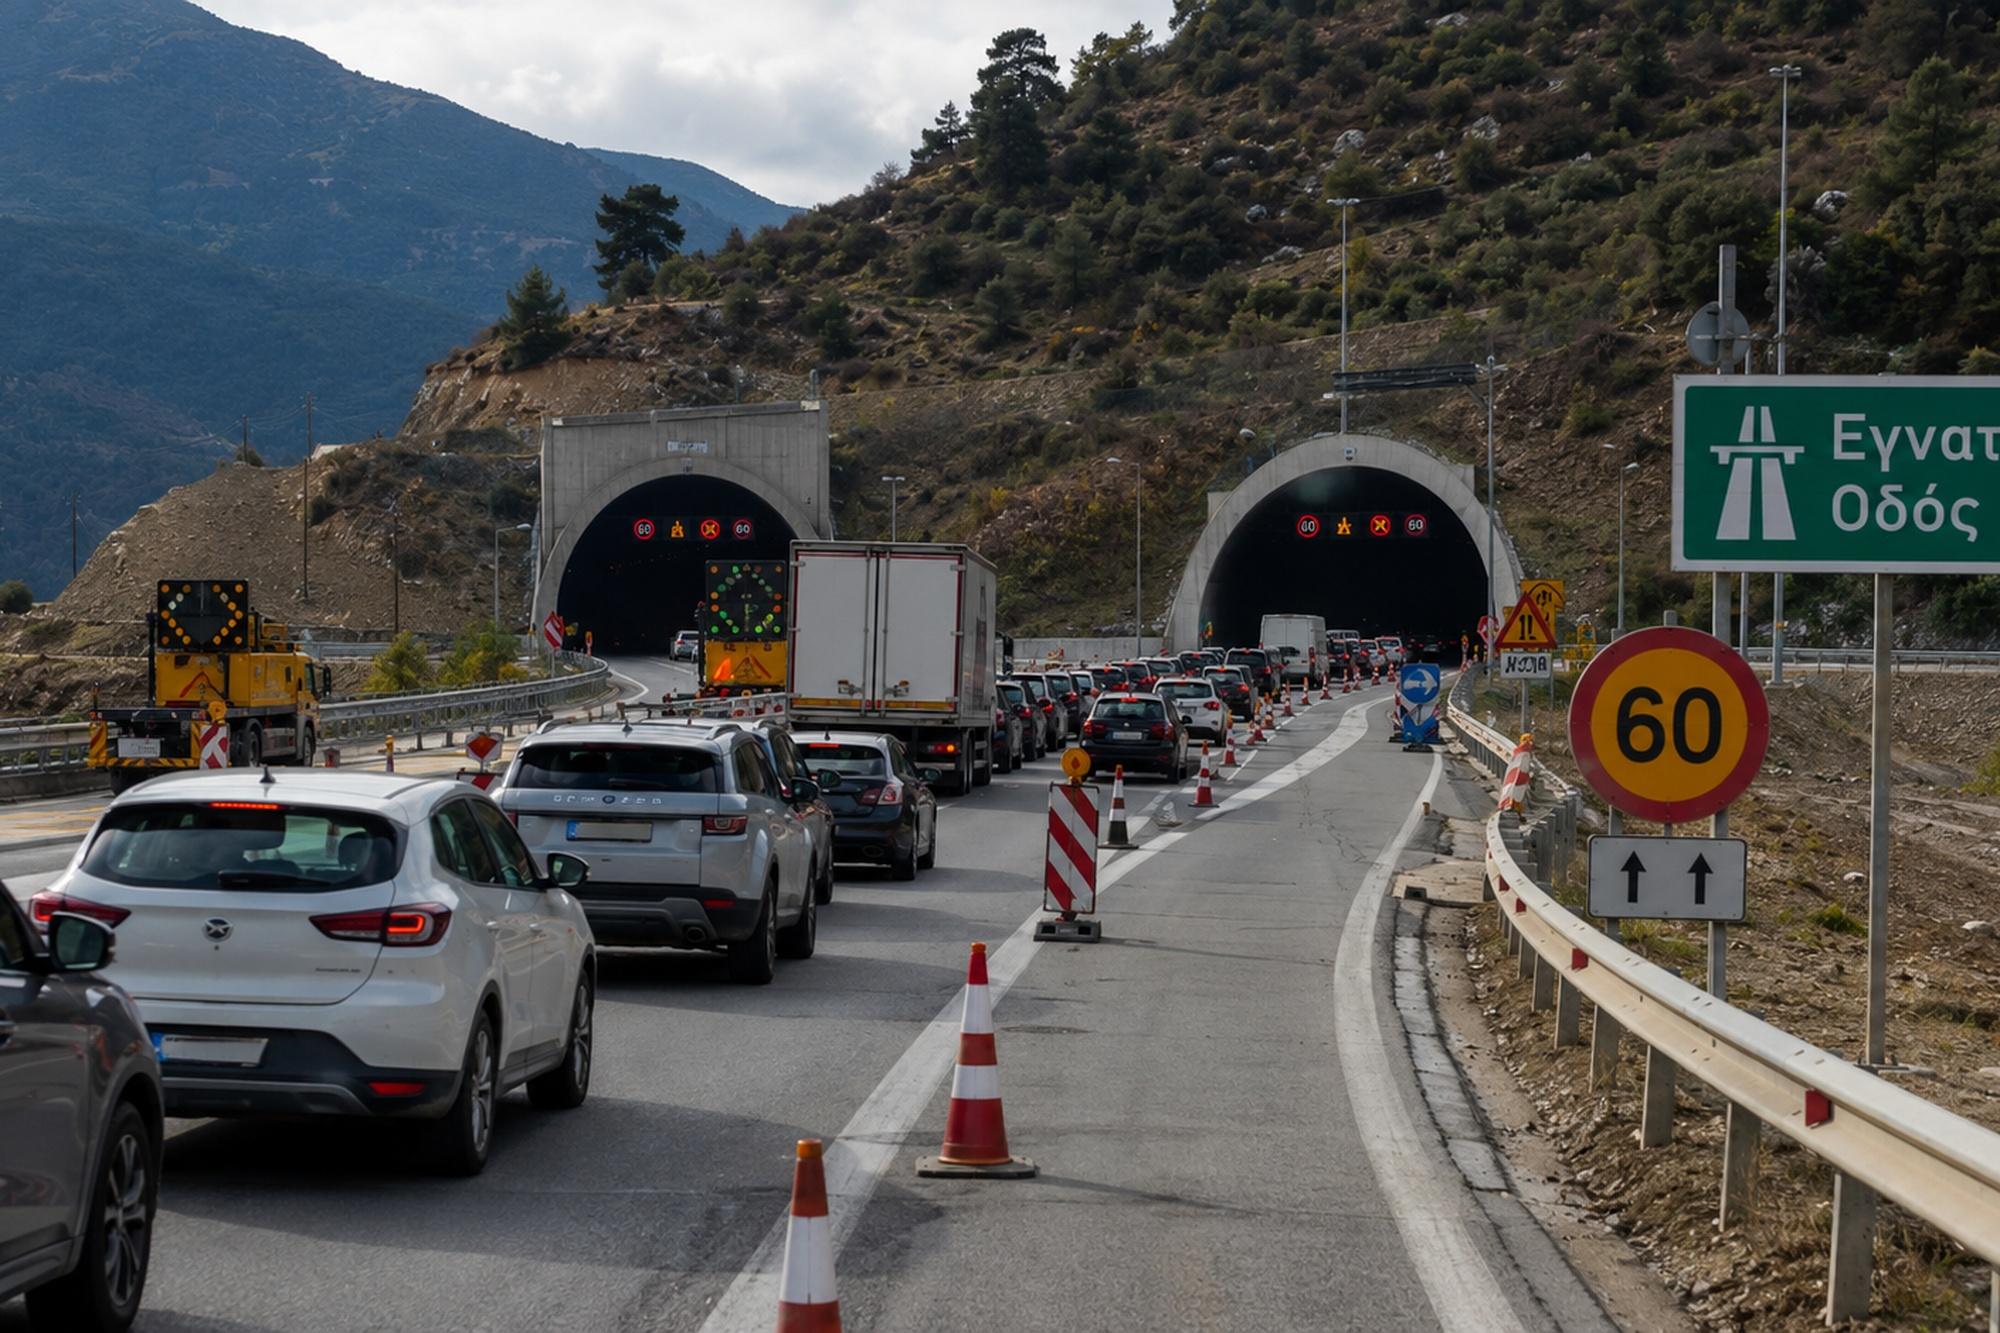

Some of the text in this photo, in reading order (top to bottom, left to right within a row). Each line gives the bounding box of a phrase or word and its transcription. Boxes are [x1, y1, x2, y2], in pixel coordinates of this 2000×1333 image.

[1833, 412, 2000, 472] Εγνατ
[1408, 519, 1423, 531] 60
[1832, 482, 1979, 543] Οδός
[1616, 686, 1722, 764] 60
